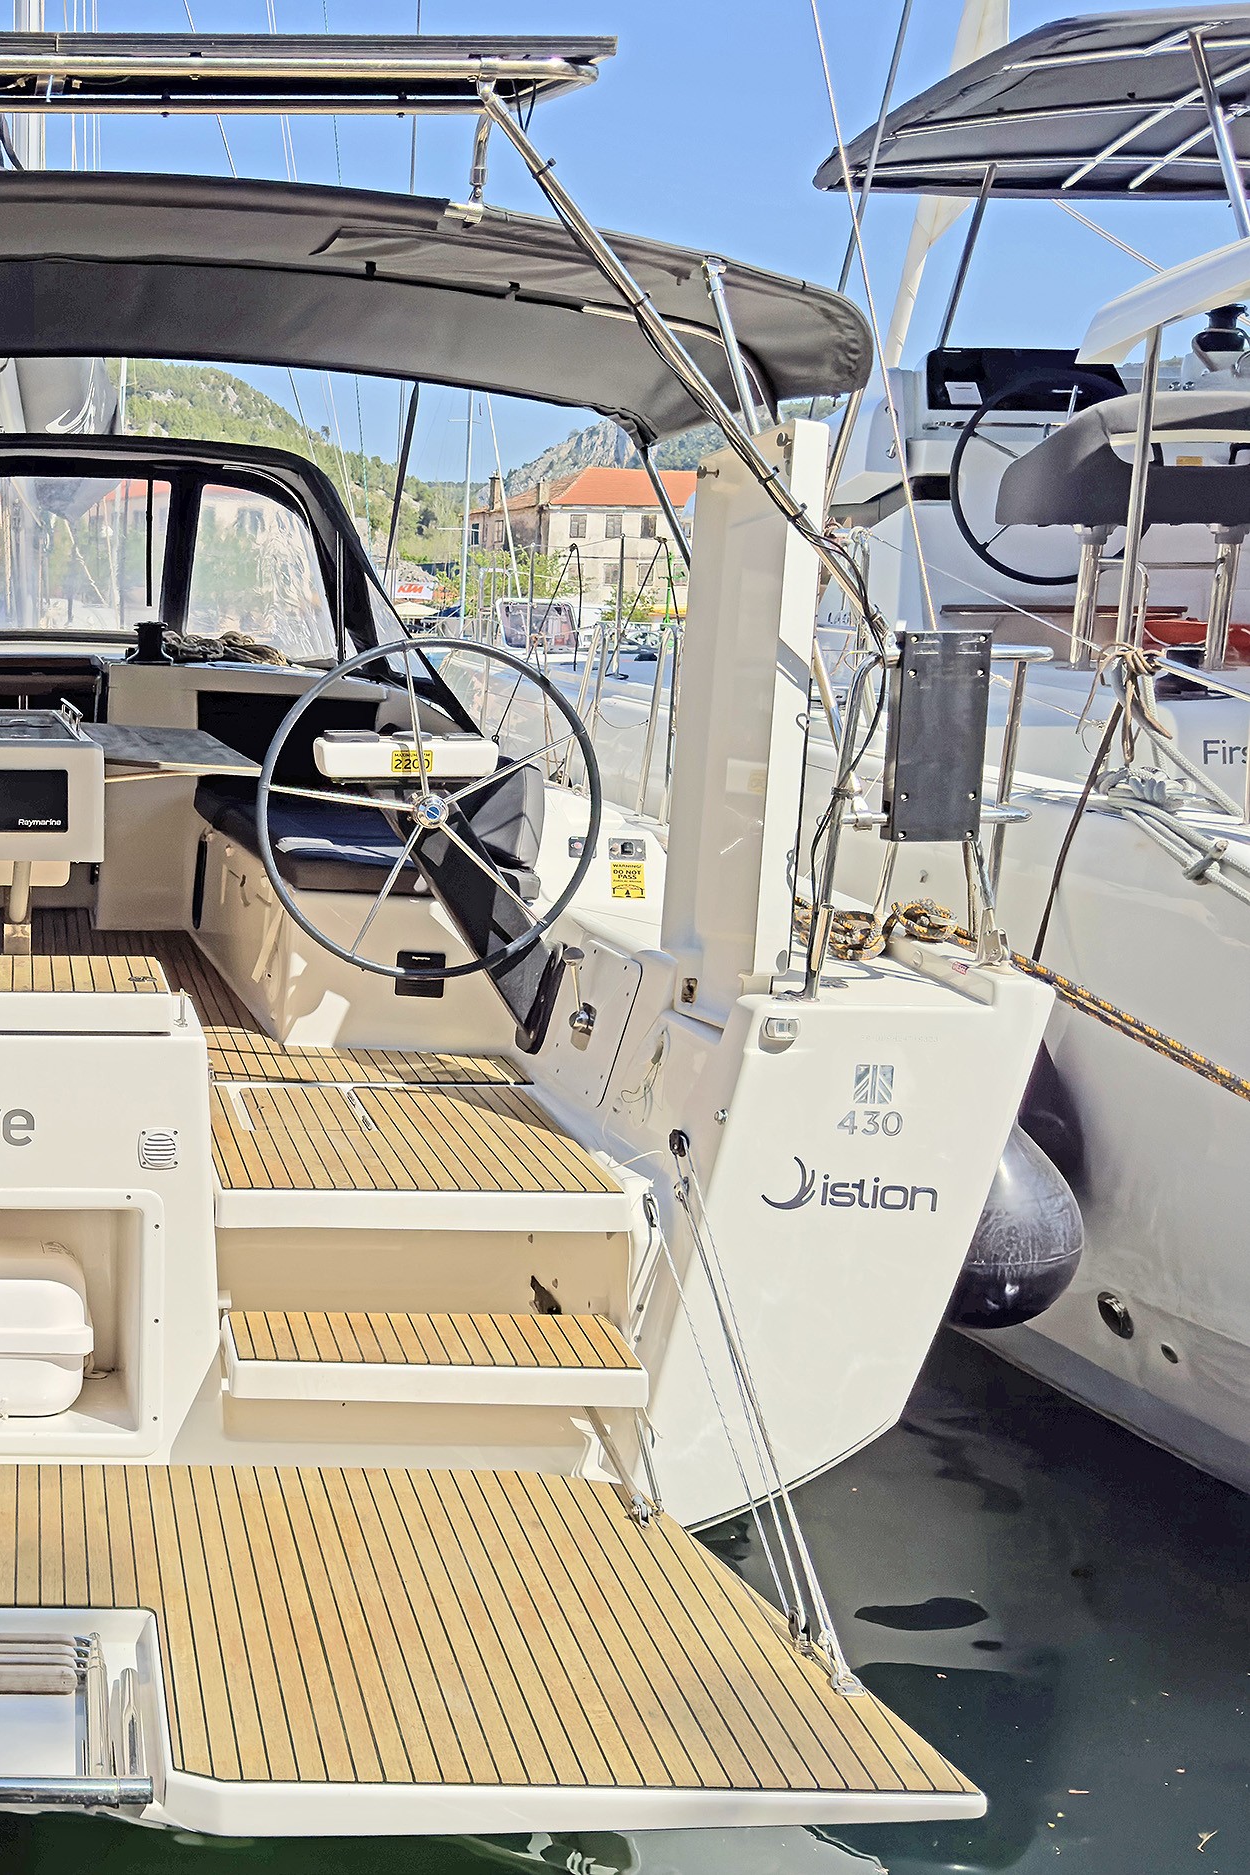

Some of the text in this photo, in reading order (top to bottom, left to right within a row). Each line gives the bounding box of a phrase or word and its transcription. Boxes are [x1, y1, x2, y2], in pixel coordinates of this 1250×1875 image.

[397, 584, 424, 593] KTM
[394, 758, 431, 770] 2200
[18, 818, 62, 828] Raymarine
[837, 1110, 903, 1137] 430
